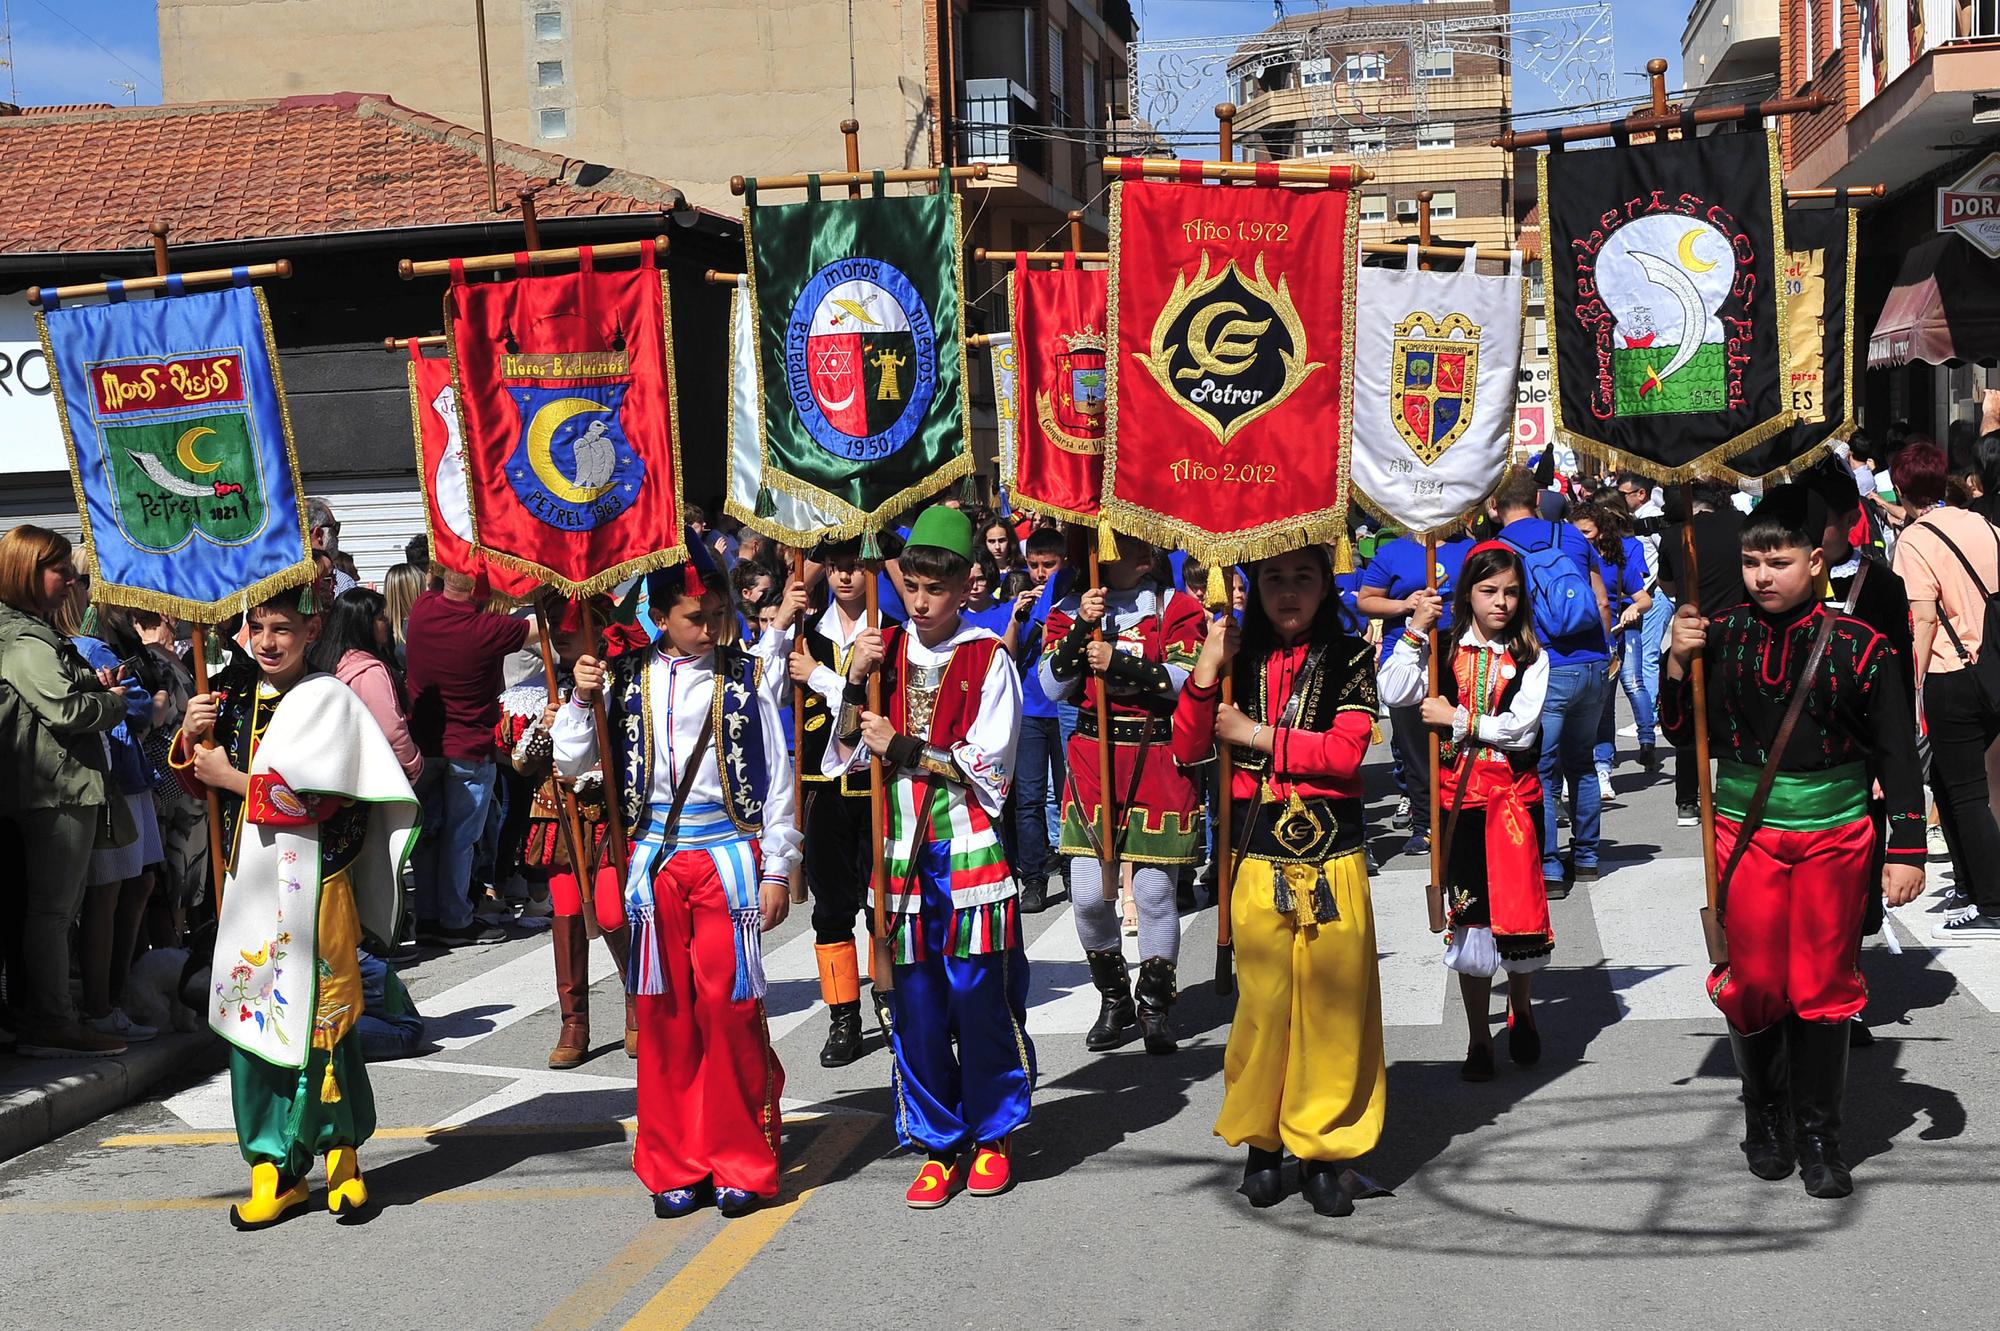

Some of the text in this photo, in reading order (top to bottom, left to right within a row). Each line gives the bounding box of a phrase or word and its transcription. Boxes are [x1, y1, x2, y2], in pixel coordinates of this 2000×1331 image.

[1182, 218, 1231, 243] Año
[823, 263, 880, 287] moros
[910, 309, 932, 384] nuevos
[507, 356, 546, 376] Moros
[788, 322, 814, 412] comparsa
[1190, 379, 1264, 405] Petrer
[846, 436, 889, 457] 1950
[1078, 441, 1089, 451] de
[1169, 458, 1277, 483] Año 2.012
[529, 489, 623, 527] PETREL 1963
